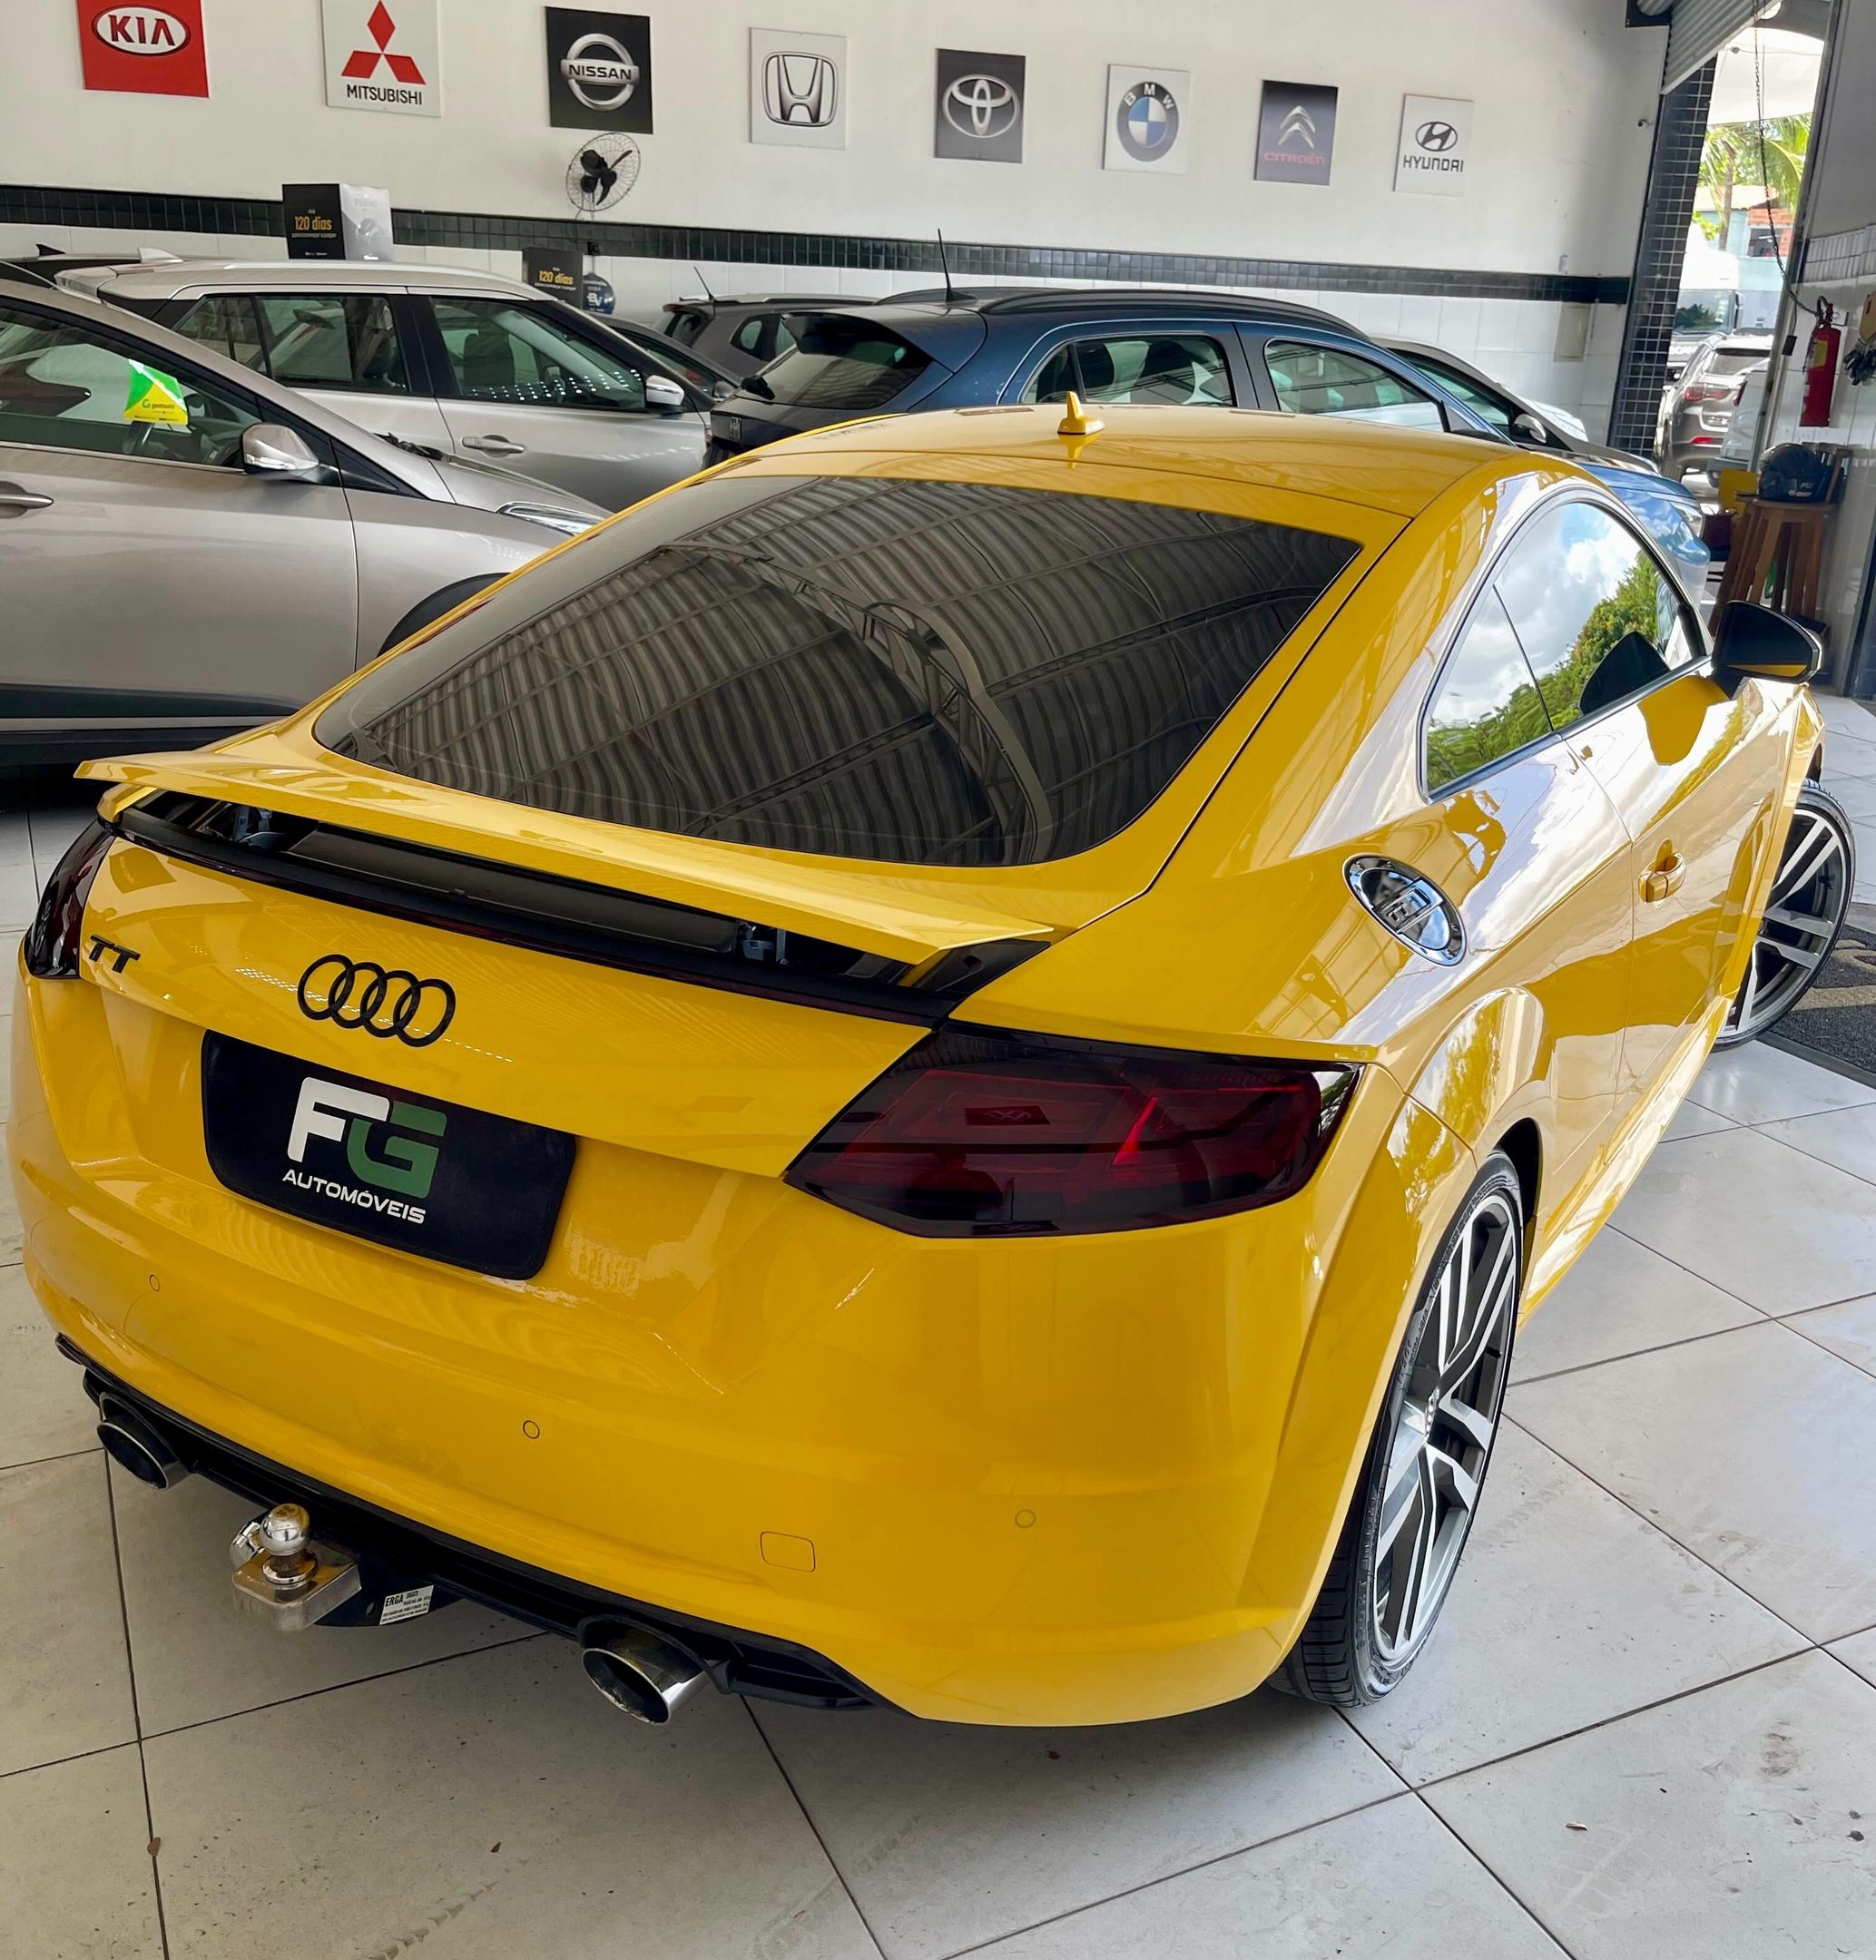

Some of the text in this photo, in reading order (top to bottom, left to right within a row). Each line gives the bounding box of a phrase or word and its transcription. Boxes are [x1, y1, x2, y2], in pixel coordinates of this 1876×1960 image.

[108, 14, 175, 46] KIA
[568, 64, 632, 81] NISSAN
[347, 83, 422, 105] MITSUBISHI
[1125, 83, 1174, 109] BMW
[1402, 154, 1464, 173] HYUNDAI
[294, 215, 333, 230] 120 dias
[538, 270, 554, 283] 120
[554, 272, 575, 285] dias
[88, 934, 142, 974] TT
[287, 1076, 447, 1199] FG
[281, 1168, 427, 1224] AUTOMÓVEIS
[385, 1593, 404, 1607] ERGA
